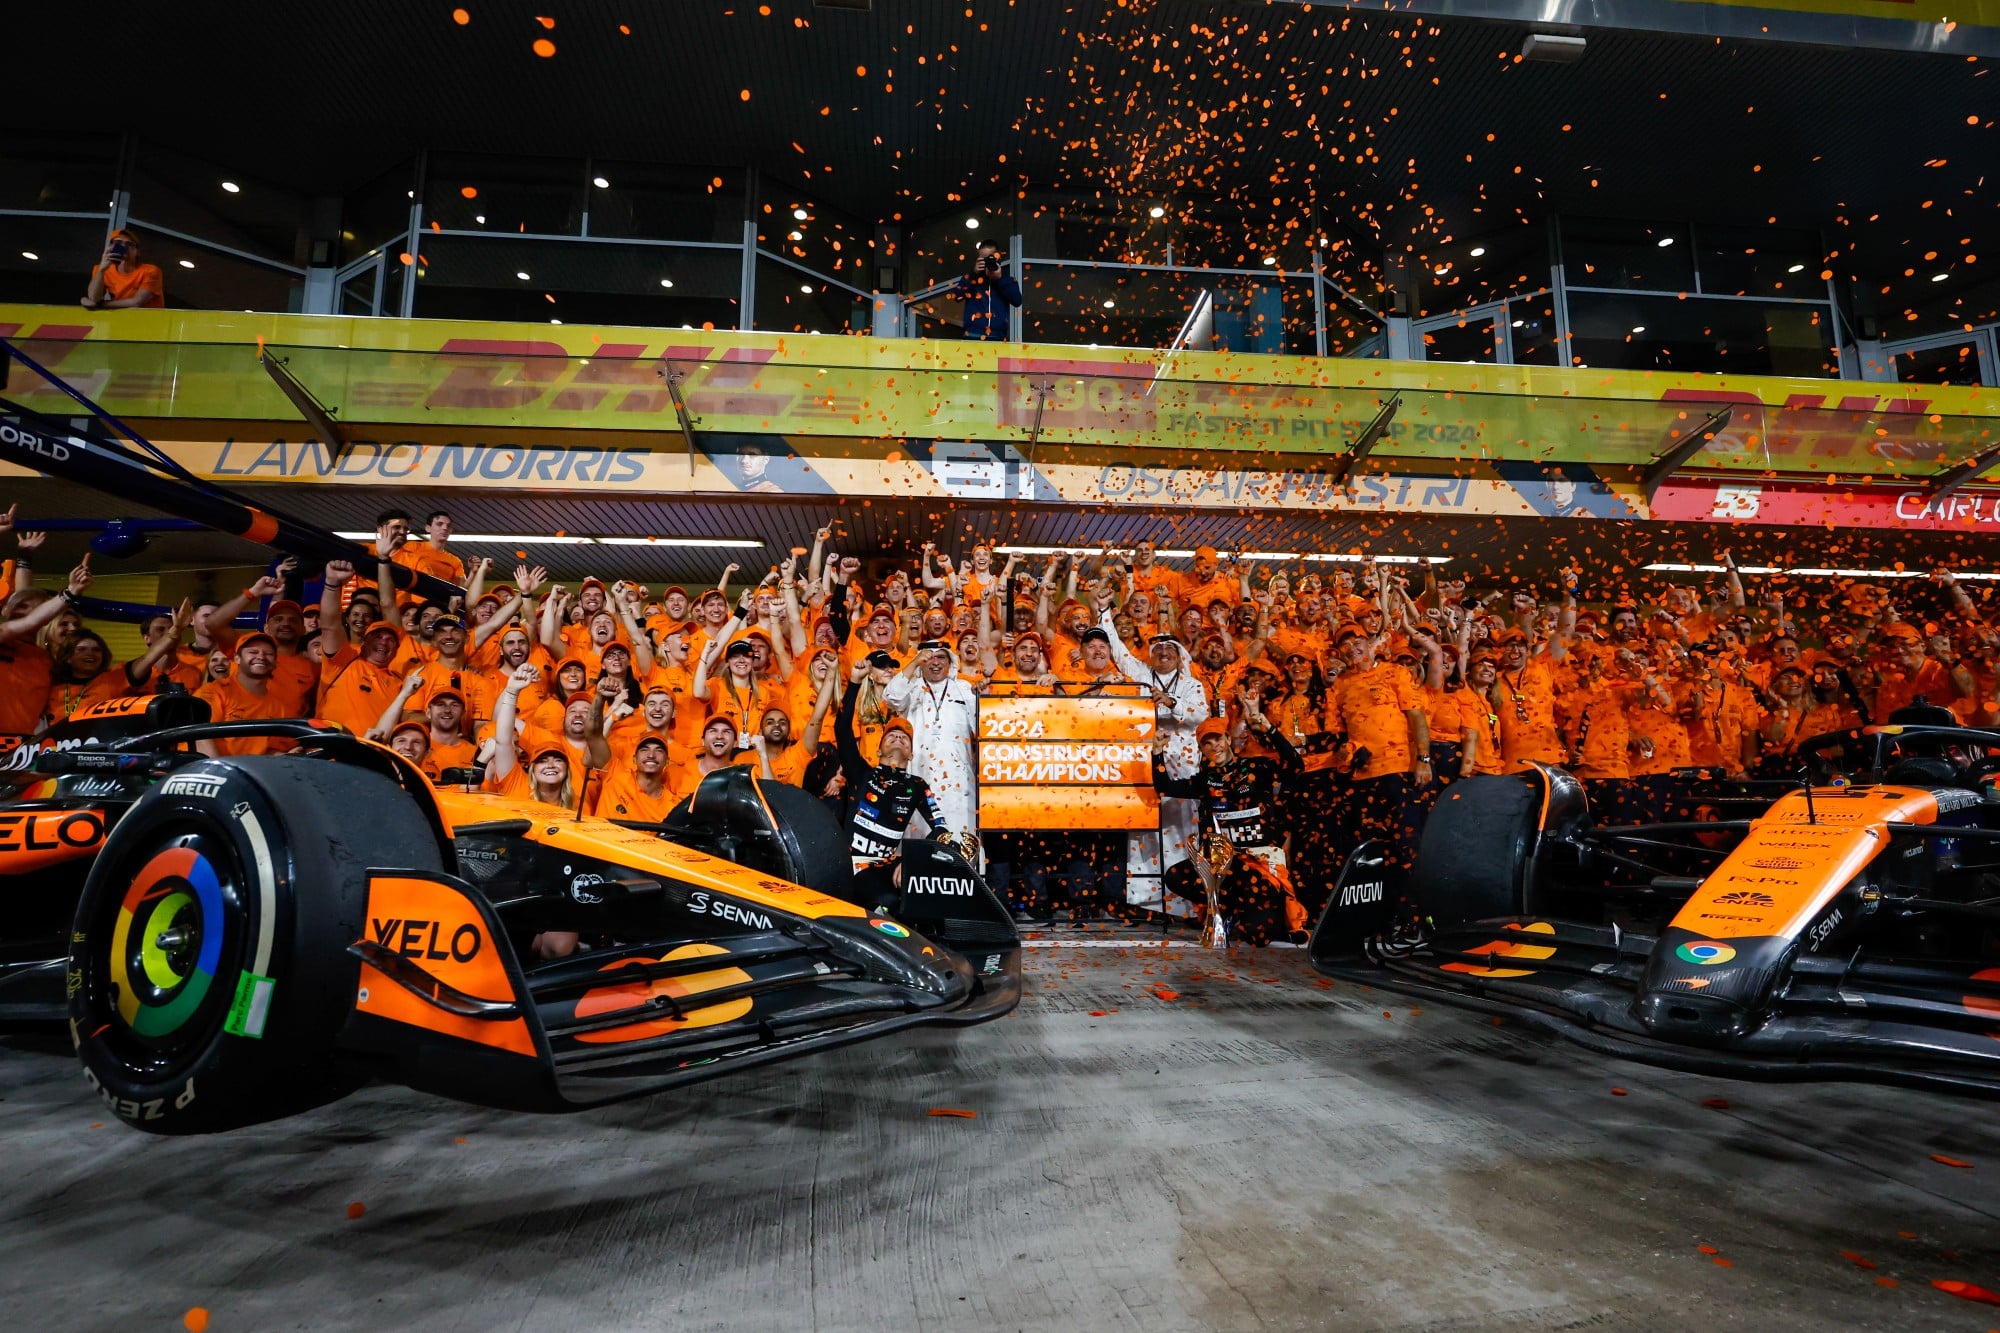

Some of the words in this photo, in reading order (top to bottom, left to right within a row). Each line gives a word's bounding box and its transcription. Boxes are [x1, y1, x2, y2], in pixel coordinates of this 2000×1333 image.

[426, 338, 795, 416] DHL
[1168, 413, 1285, 436] FASTEST
[1291, 418, 1331, 438] PIT
[1339, 419, 1407, 440] STP
[1413, 423, 1477, 443] 2024
[1656, 388, 1950, 460] DHL
[0, 426, 70, 461] ORLD
[212, 437, 424, 478] LANDO
[429, 442, 653, 482] NORRIS
[1098, 461, 1269, 500] OSCAR
[1711, 484, 1763, 519] 55
[1896, 492, 2000, 522] CARL
[985, 719, 1044, 738] 2024
[160, 773, 228, 798] PIRELLI
[982, 763, 1122, 782] CHAMPIONS
[0, 812, 104, 851] ELO
[1759, 841, 1832, 849] webex
[456, 847, 498, 861] cLaren
[907, 876, 975, 897] ARROW
[1339, 880, 1383, 907] ARROW
[711, 901, 774, 930] SENNA
[1712, 898, 1775, 908] CNBC
[1818, 908, 1843, 941] SENNA
[372, 918, 481, 963] VELO
[83, 1066, 164, 1120] ZERO
[175, 1076, 196, 1110] P
